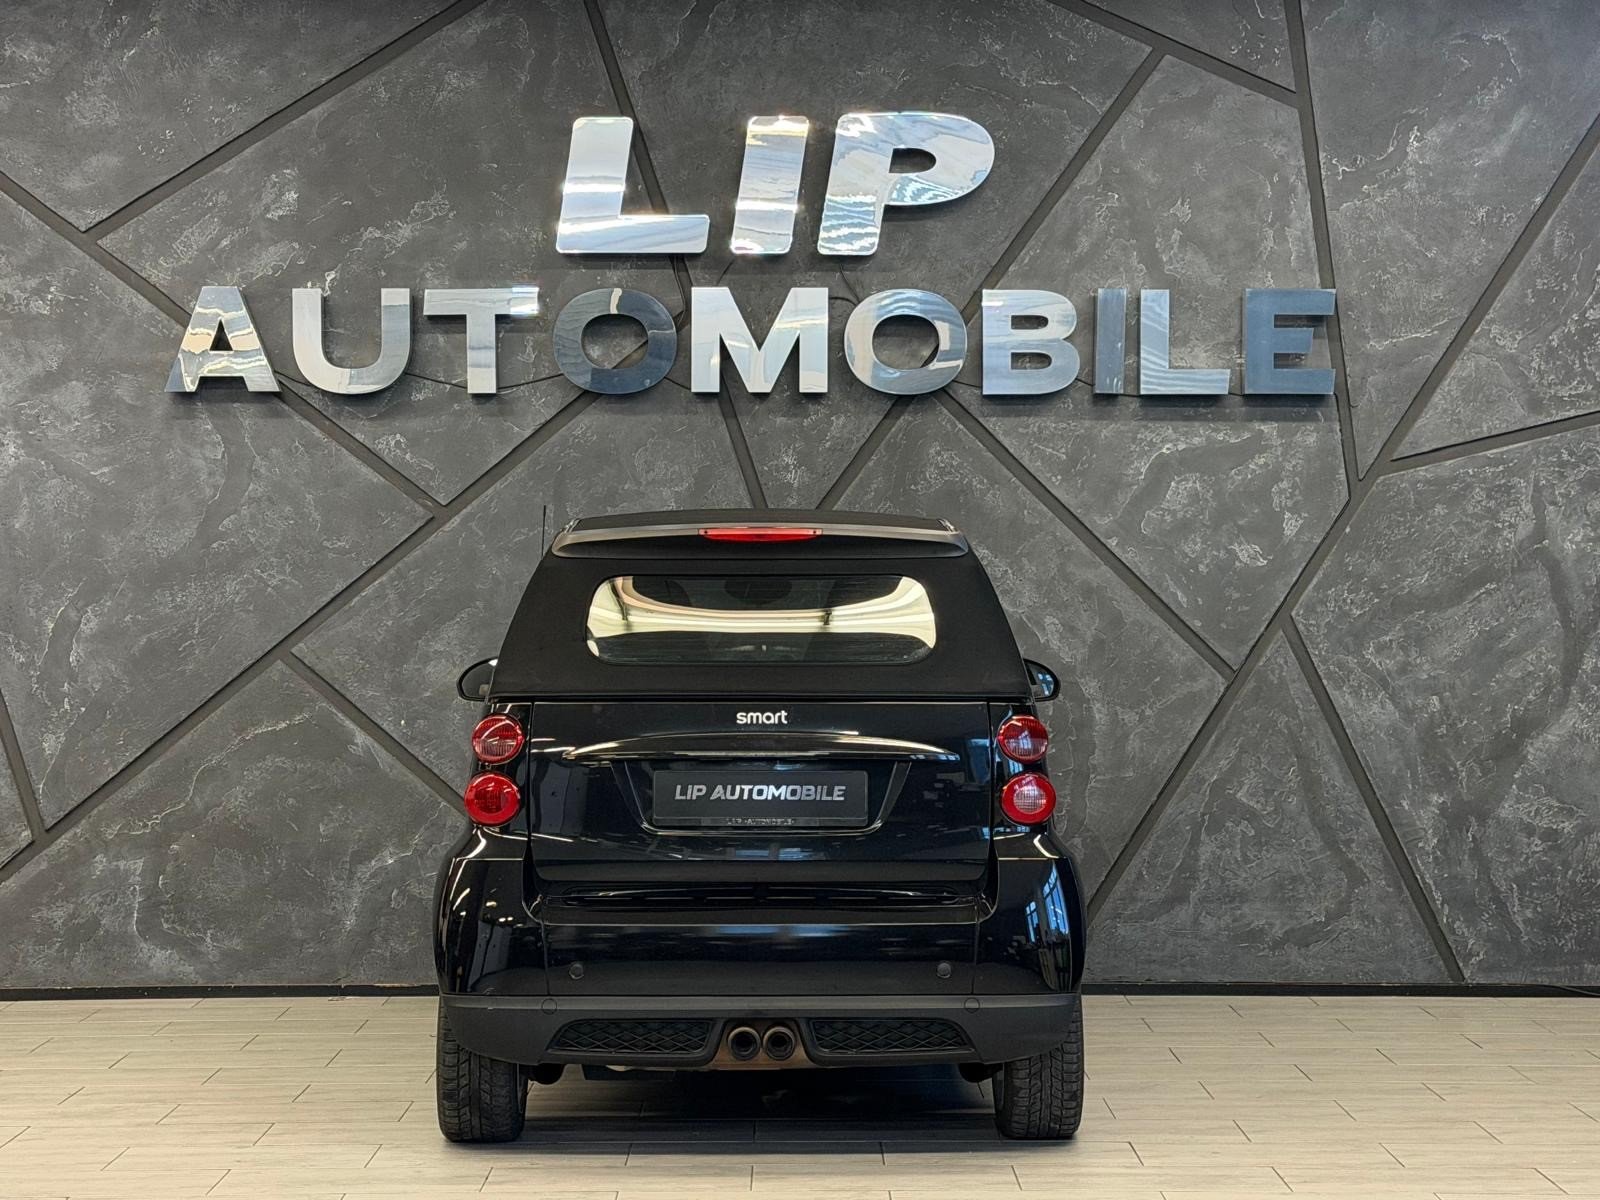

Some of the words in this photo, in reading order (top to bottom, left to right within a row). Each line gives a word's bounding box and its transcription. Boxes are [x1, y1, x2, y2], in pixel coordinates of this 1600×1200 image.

[555, 111, 995, 256] LIP
[165, 285, 1336, 395] AUTOMOBILE
[736, 710, 788, 725] smart
[674, 784, 706, 800] LIP
[710, 784, 846, 801] AUTOMOBILE
